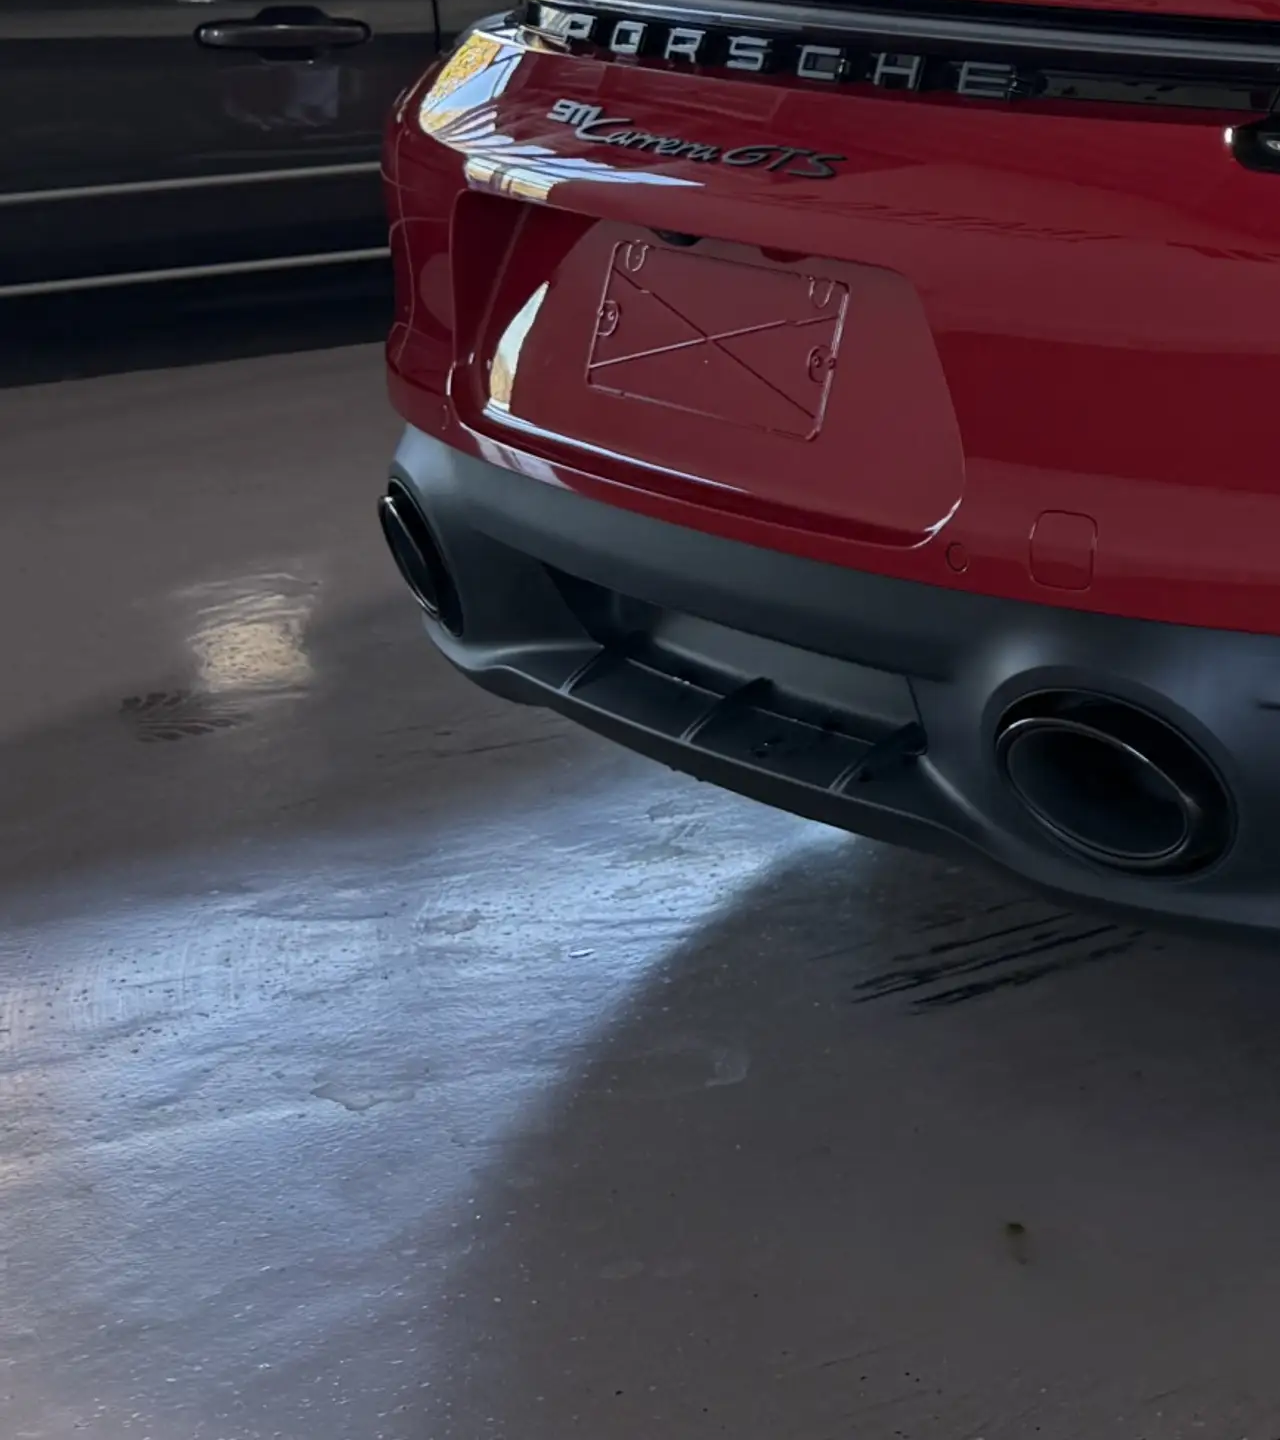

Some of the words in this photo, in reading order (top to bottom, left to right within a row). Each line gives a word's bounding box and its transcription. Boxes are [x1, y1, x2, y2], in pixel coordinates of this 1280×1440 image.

[561, 12, 1016, 99] PORSCHE
[546, 98, 603, 127] 911
[575, 117, 721, 161] Carrera
[721, 144, 848, 179] GTS
